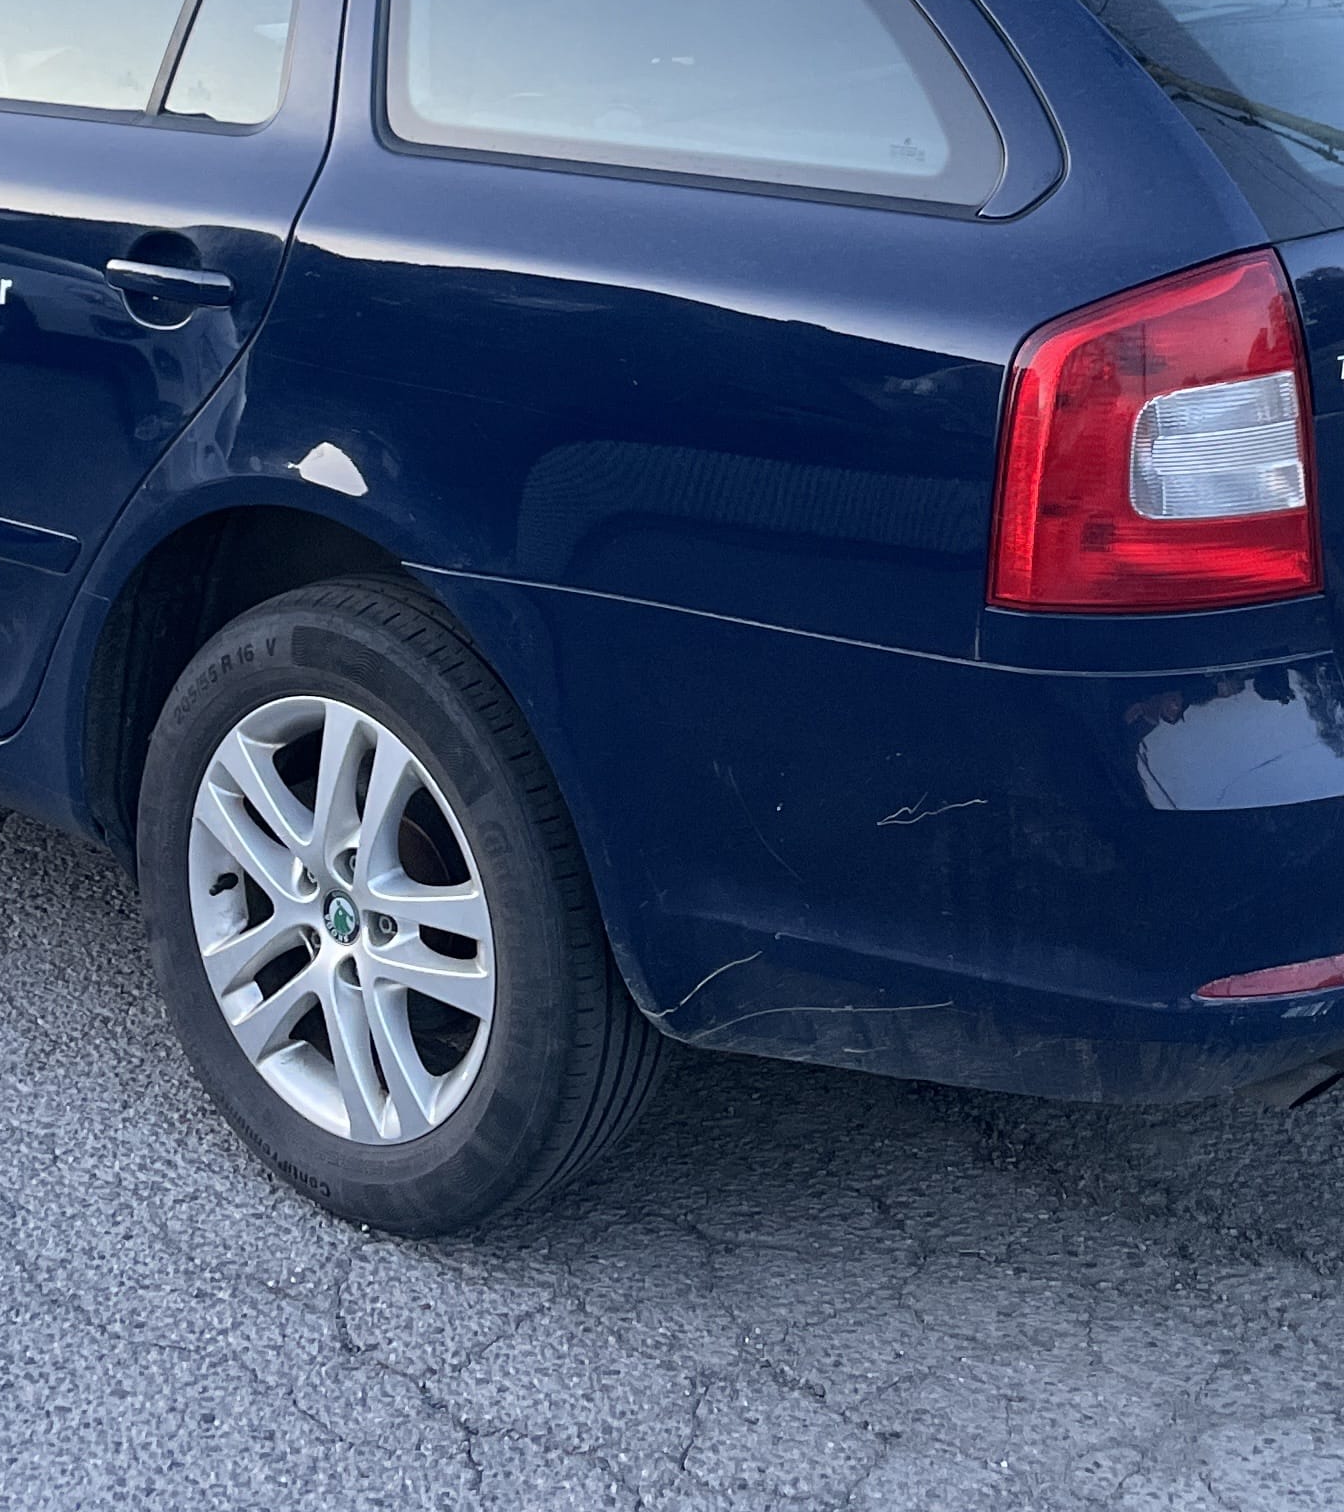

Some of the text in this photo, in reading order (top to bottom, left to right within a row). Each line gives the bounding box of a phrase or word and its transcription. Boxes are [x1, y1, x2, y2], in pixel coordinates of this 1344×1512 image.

[220, 654, 233, 675] R
[237, 643, 254, 665] 16
[265, 637, 276, 657] V
